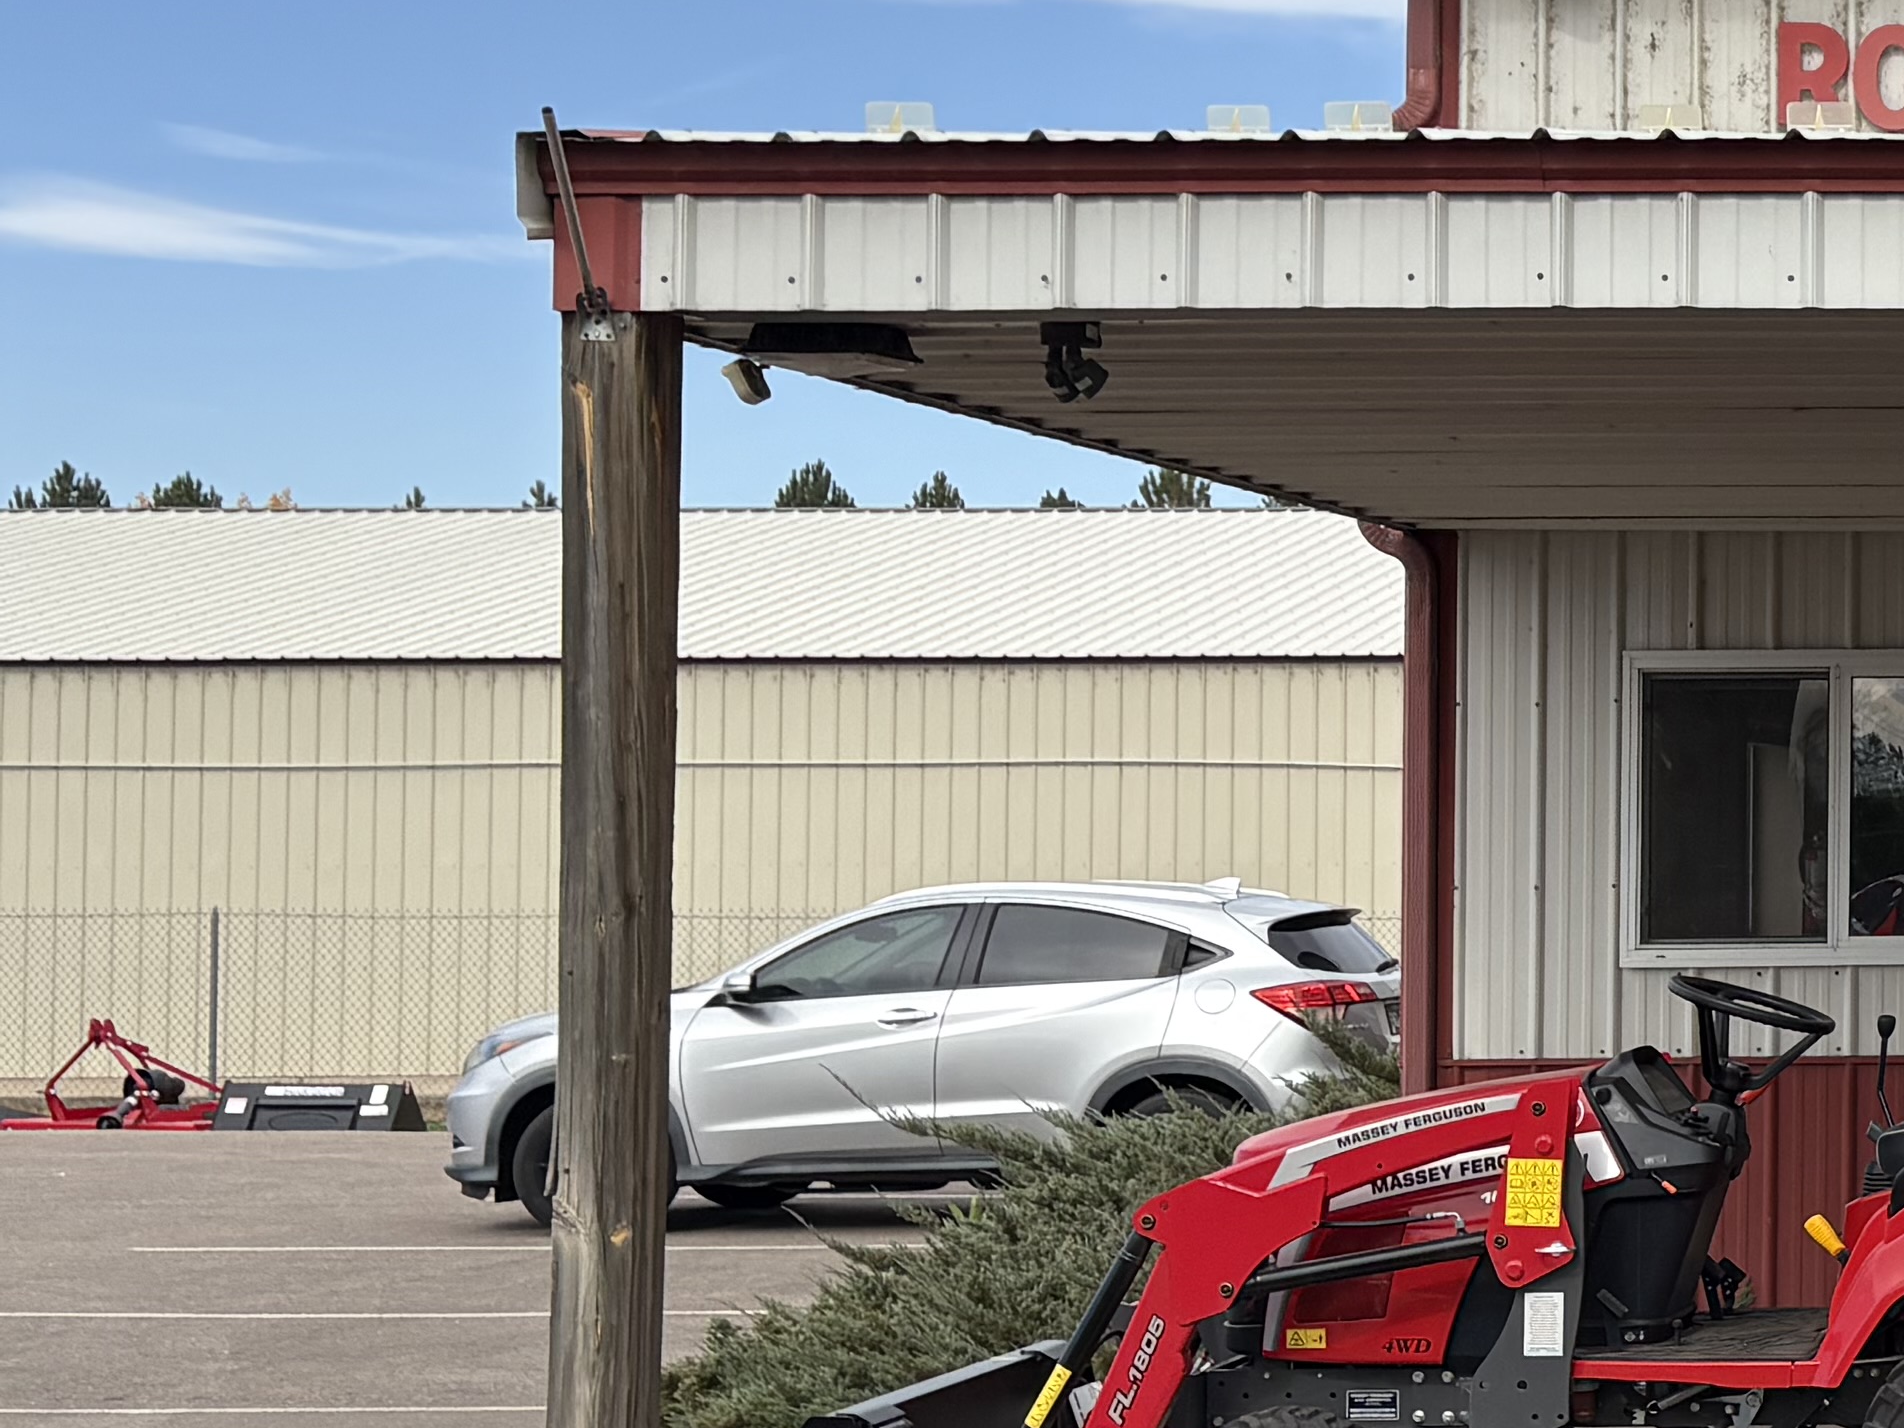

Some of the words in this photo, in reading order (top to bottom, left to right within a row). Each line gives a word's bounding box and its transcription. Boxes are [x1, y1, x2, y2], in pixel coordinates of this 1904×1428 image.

[1336, 1121, 1399, 1149] MASSEY
[1403, 1101, 1487, 1131] FERGUSON
[1371, 1163, 1453, 1195] MASSEY
[1459, 1153, 1509, 1177] FERG
[1382, 1338, 1432, 1353] 4WD
